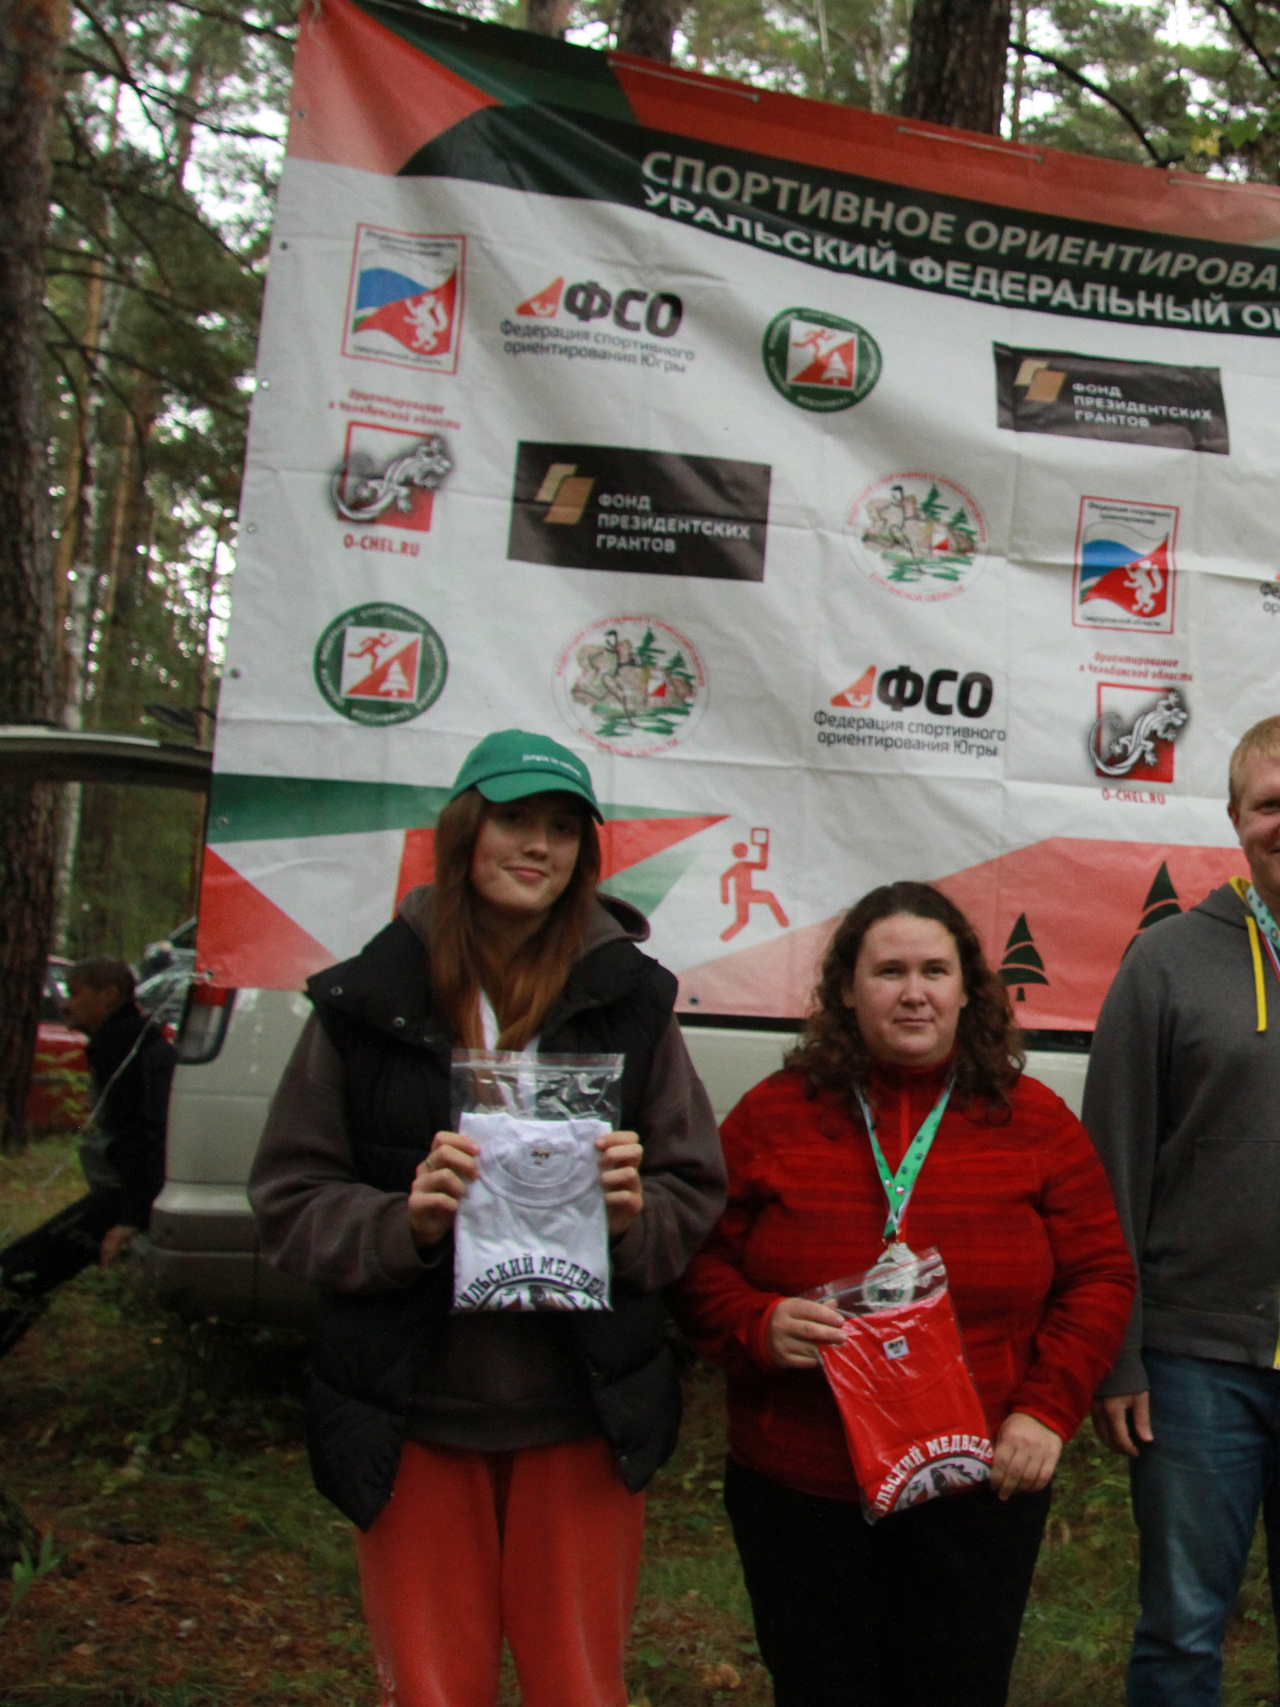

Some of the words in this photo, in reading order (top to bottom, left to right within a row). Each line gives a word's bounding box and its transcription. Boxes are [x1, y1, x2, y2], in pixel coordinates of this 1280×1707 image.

[641, 151, 957, 244] СПОРТИВНОЕ
[642, 183, 897, 278] УРАЛЬСКИЙ
[908, 255, 1232, 328] ФЕДЕРАЛЬНЫЙ
[563, 280, 684, 338] ФСО
[500, 319, 590, 342] Федерация
[593, 331, 696, 362] спортивного
[503, 340, 638, 366] ориентирования
[640, 352, 687, 373] Югры
[1072, 382, 1123, 399] ФОНД
[1073, 395, 1213, 421] ПРЕЗИДЕНТСКИХ
[1075, 410, 1150, 429] ГРАНТОВ
[598, 493, 652, 512] ФОНД
[598, 513, 750, 540] ПРЕЗИДЕНТСКИХ
[596, 533, 677, 554] ГРАНТОВ
[877, 664, 993, 718] ФСО
[813, 710, 904, 731] Федерация
[907, 721, 1006, 741] спортивного
[817, 731, 949, 754] ориентирования
[953, 739, 999, 759] Югры
